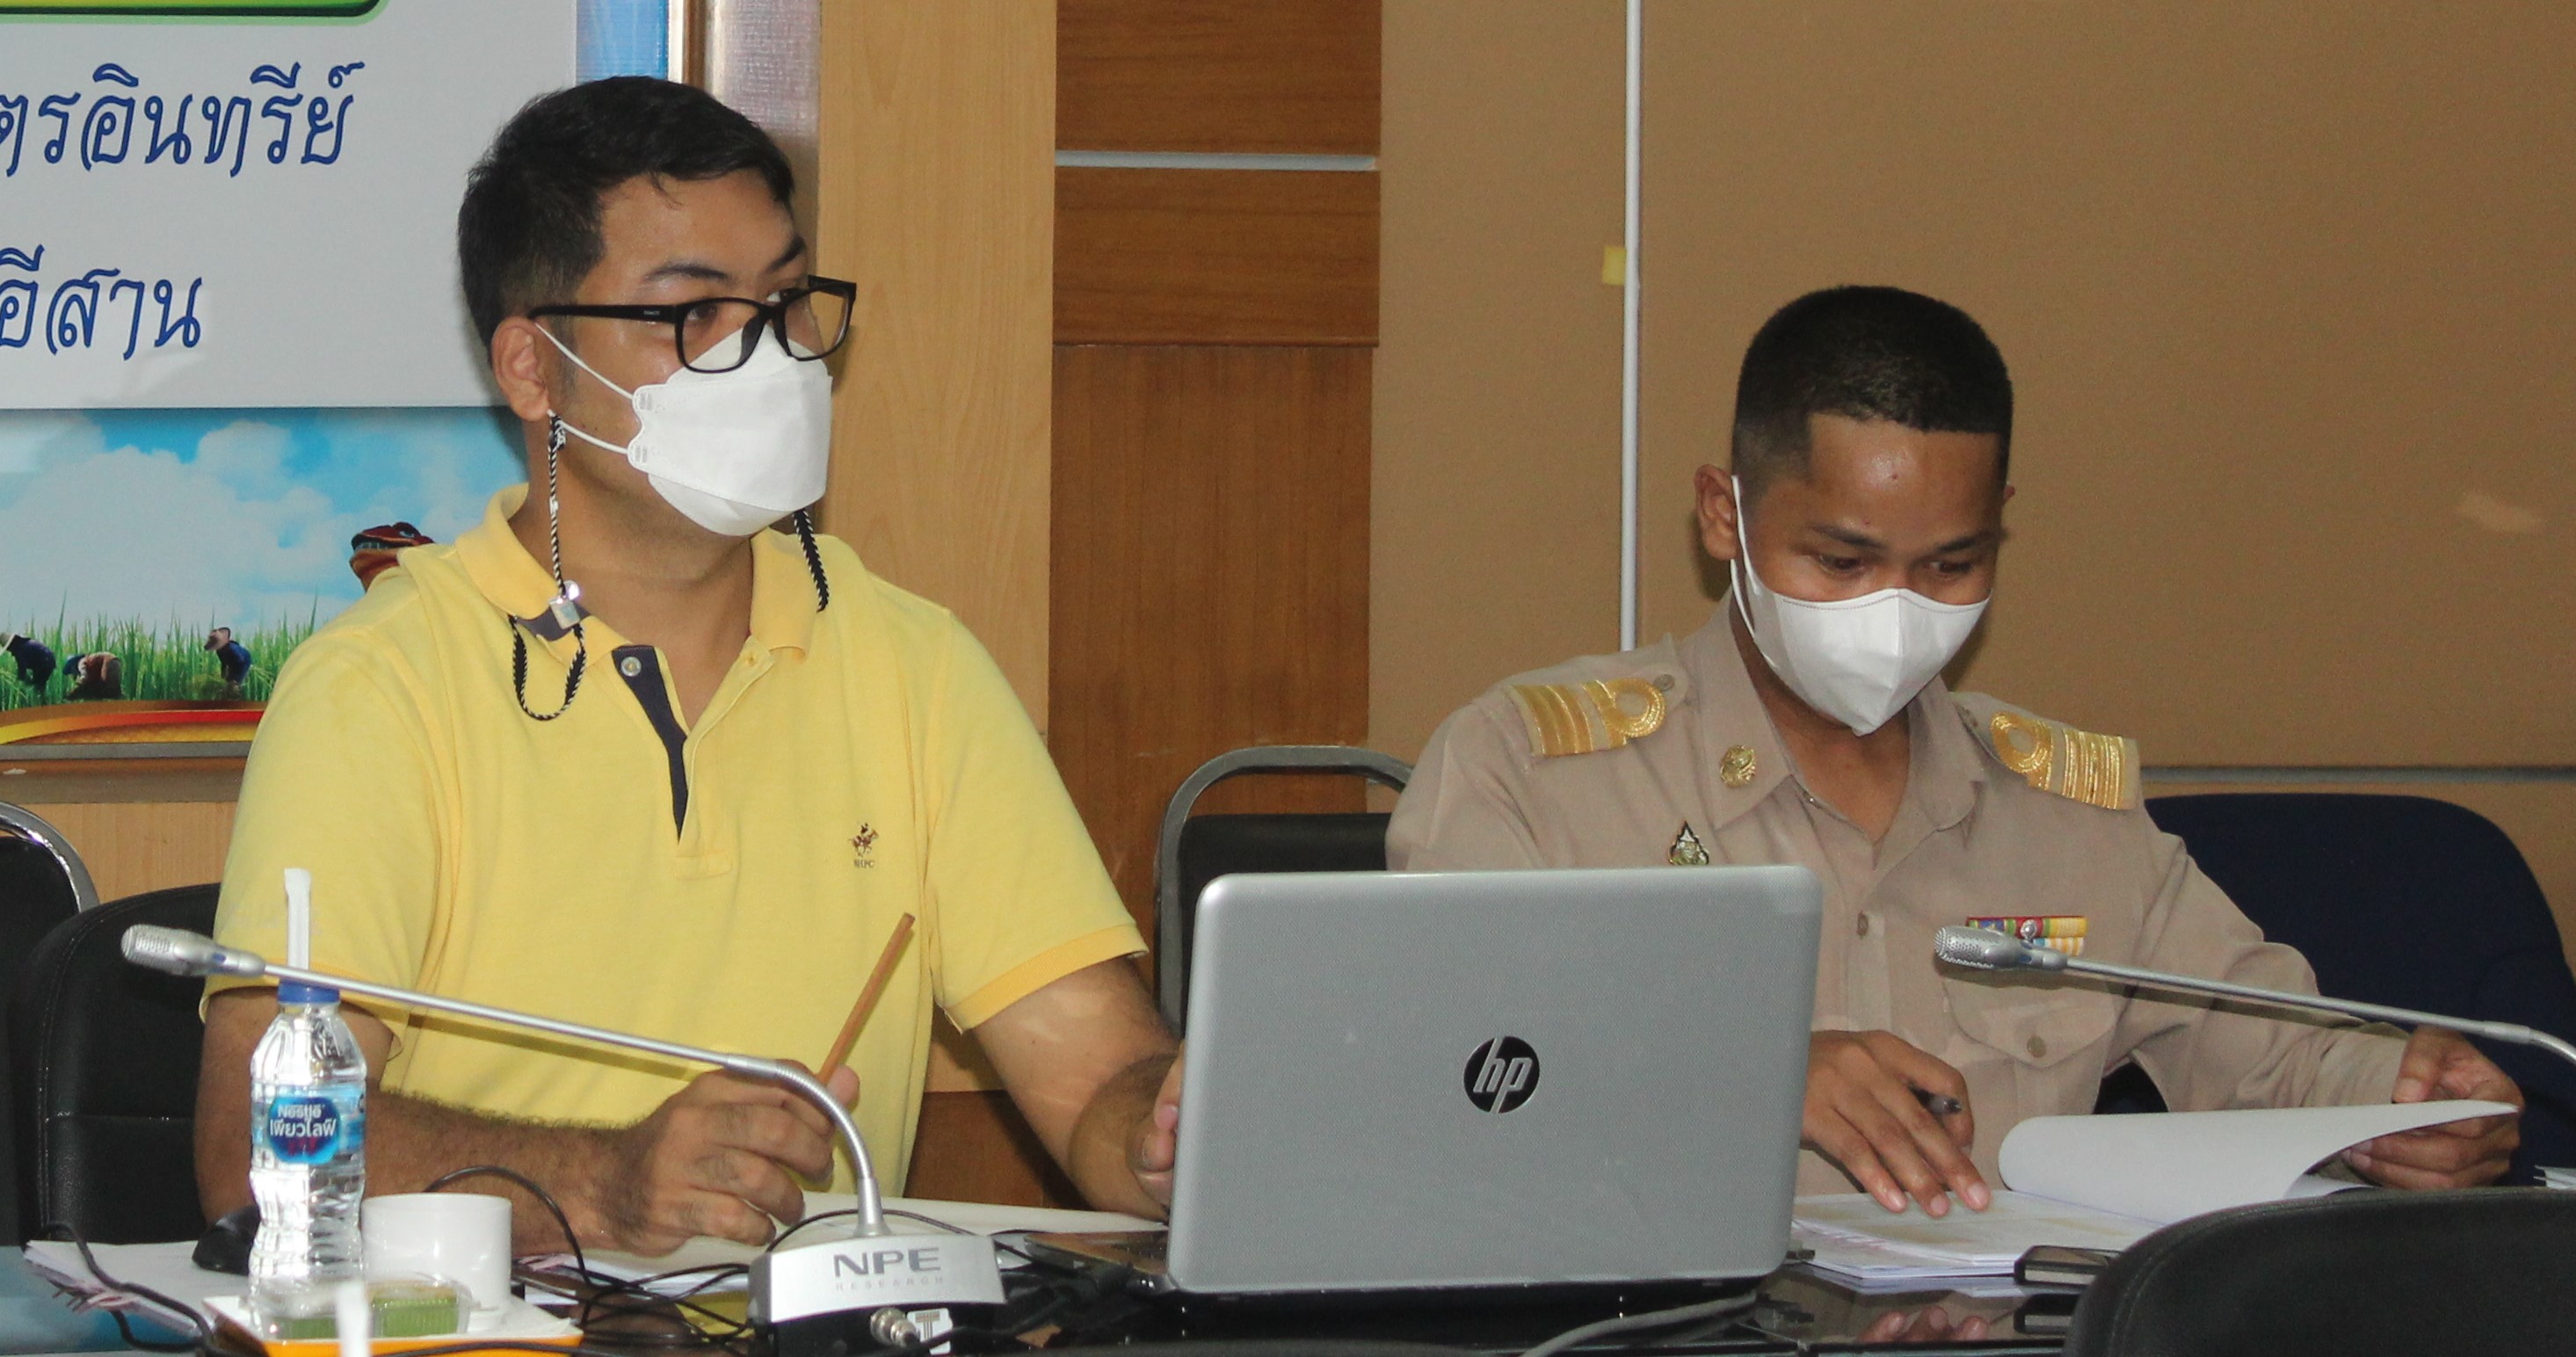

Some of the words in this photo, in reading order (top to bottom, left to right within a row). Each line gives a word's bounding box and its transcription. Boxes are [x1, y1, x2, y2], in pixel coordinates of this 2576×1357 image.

[0, 243, 202, 360] อีสาน
[1471, 1037, 1535, 1114] hp
[833, 1246, 941, 1277] NPE
[836, 1276, 943, 1290] RESEARCH
